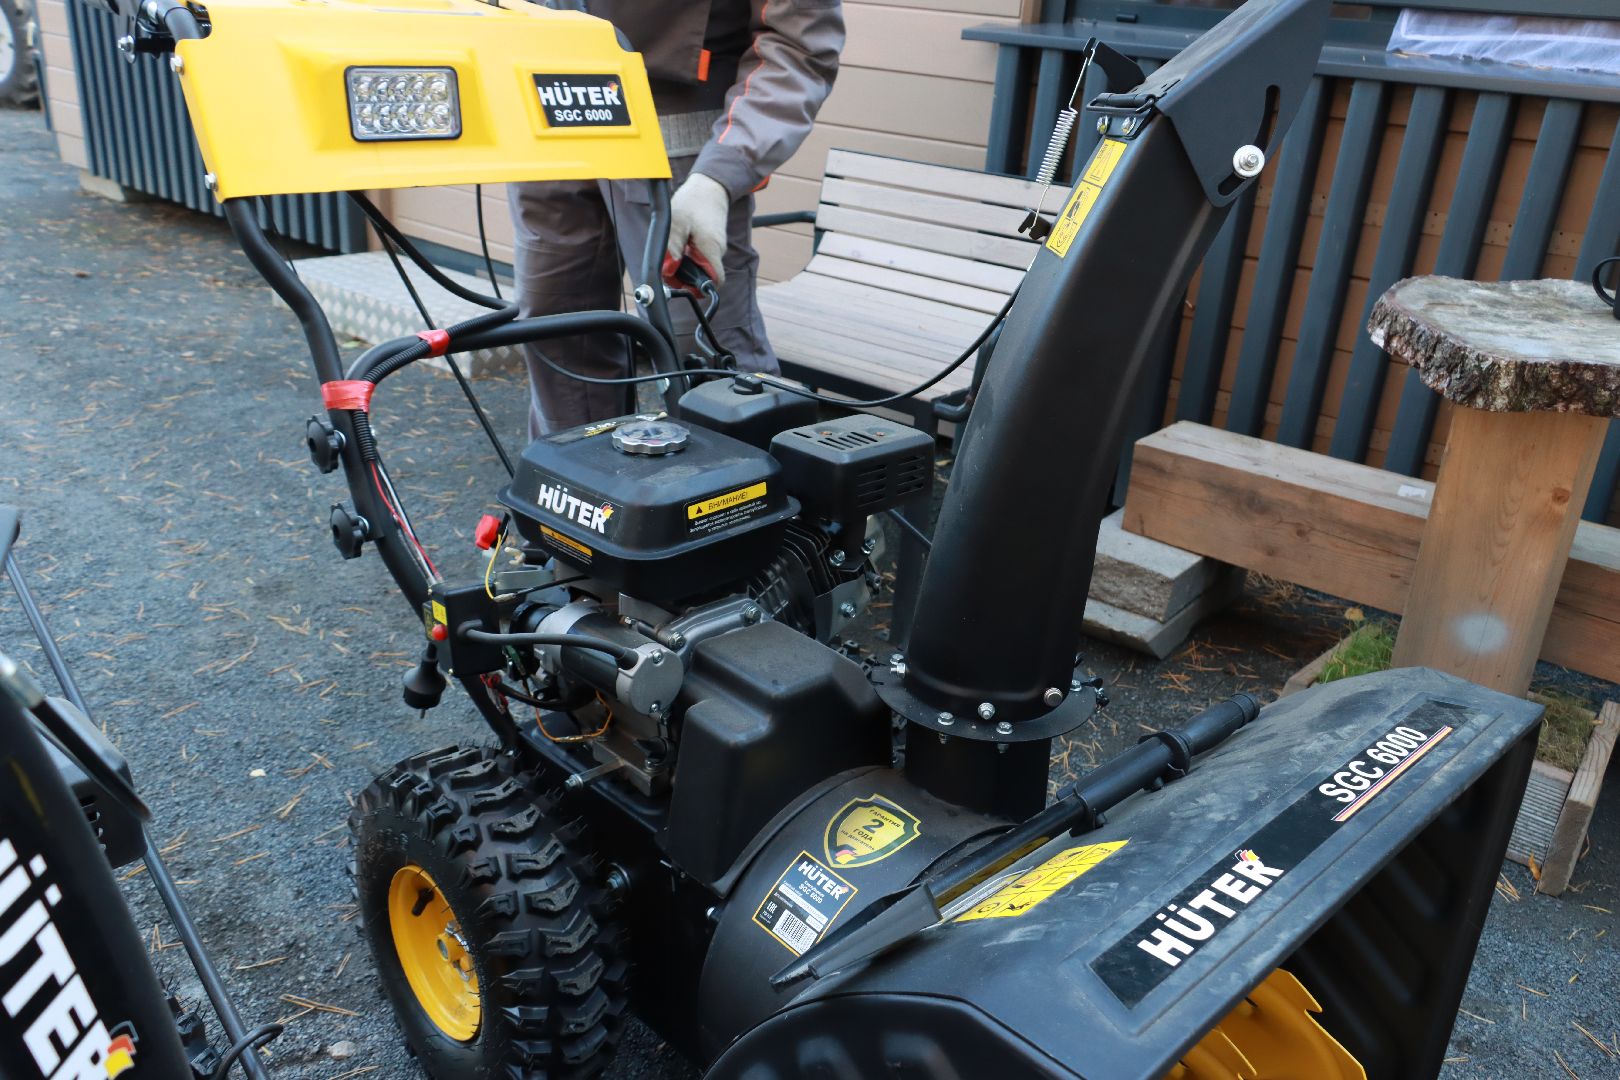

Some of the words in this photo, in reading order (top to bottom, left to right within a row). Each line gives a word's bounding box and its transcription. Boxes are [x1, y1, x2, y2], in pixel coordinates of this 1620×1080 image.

[537, 82, 621, 106] HÜTER
[554, 109, 583, 121] SGC
[585, 109, 613, 121] 6000
[537, 484, 607, 534] HÜTER
[1318, 760, 1383, 803] SGC
[1367, 726, 1428, 768] 6000
[862, 818, 885, 834] 2
[869, 809, 901, 828] ГАРАНТИЯ
[853, 828, 873, 842] ГОДА
[797, 860, 844, 901] HÜTER
[1136, 858, 1284, 967] HÜTER
